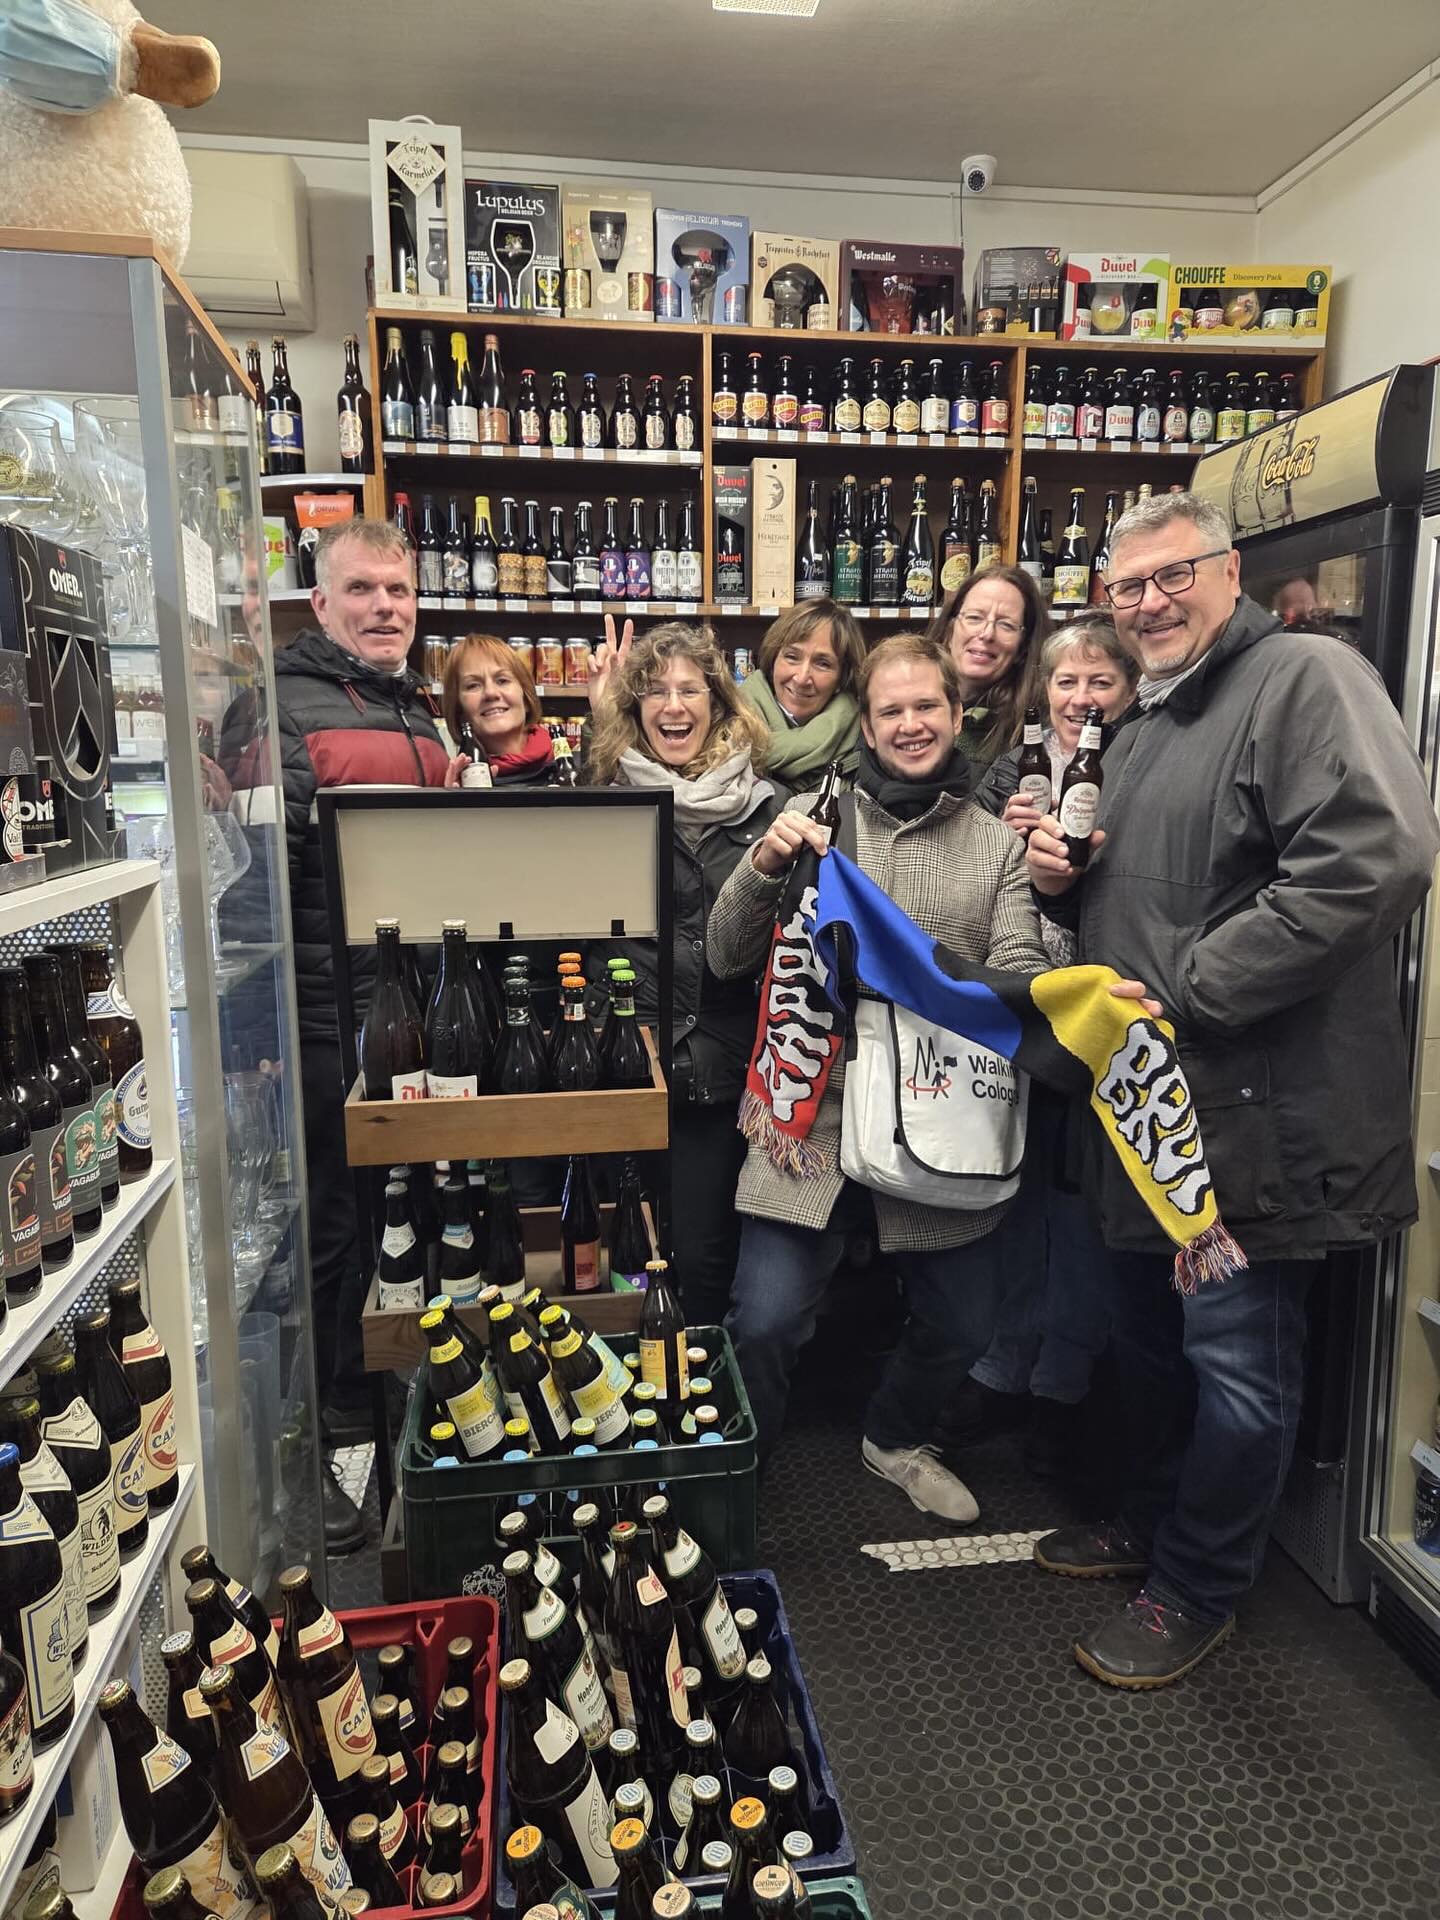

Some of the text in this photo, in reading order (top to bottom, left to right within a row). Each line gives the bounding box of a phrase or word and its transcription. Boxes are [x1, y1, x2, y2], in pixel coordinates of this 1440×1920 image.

[475, 190, 546, 216] Lupulus
[853, 249, 897, 262] Westmalle
[1101, 258, 1137, 272] Duvel
[1174, 266, 1282, 284] CHOUFFE Discovery Pack
[717, 475, 747, 487] Duvel
[967, 1054, 1017, 1079] Walkin
